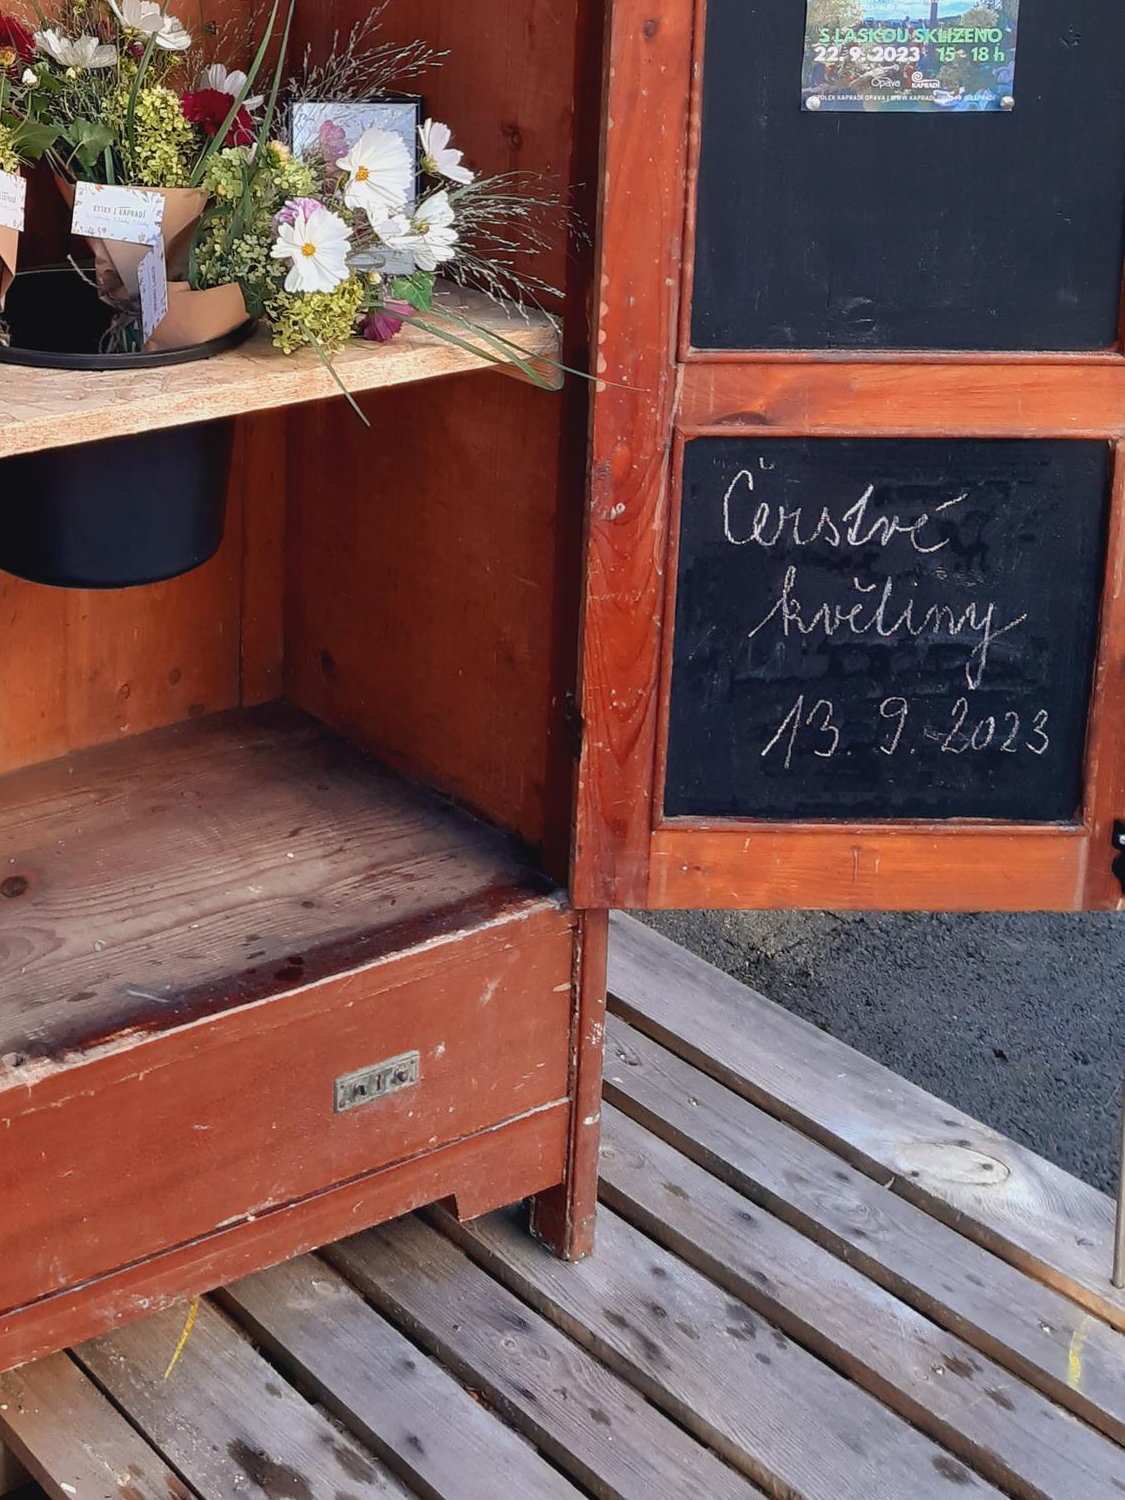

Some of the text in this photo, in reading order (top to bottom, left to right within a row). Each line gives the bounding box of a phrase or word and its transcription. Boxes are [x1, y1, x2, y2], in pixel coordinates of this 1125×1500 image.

[813, 46, 845, 62] 22.
[869, 46, 921, 62] 2023
[937, 46, 956, 62] 15
[971, 46, 990, 62] 18
[993, 45, 1005, 62] h
[819, 28, 831, 43] S
[912, 28, 1004, 43] SKLIZENO
[870, 77, 901, 89] Opava
[723, 457, 969, 553] Čerstvé
[748, 565, 1028, 691] květiny
[940, 697, 1050, 756] 2023
